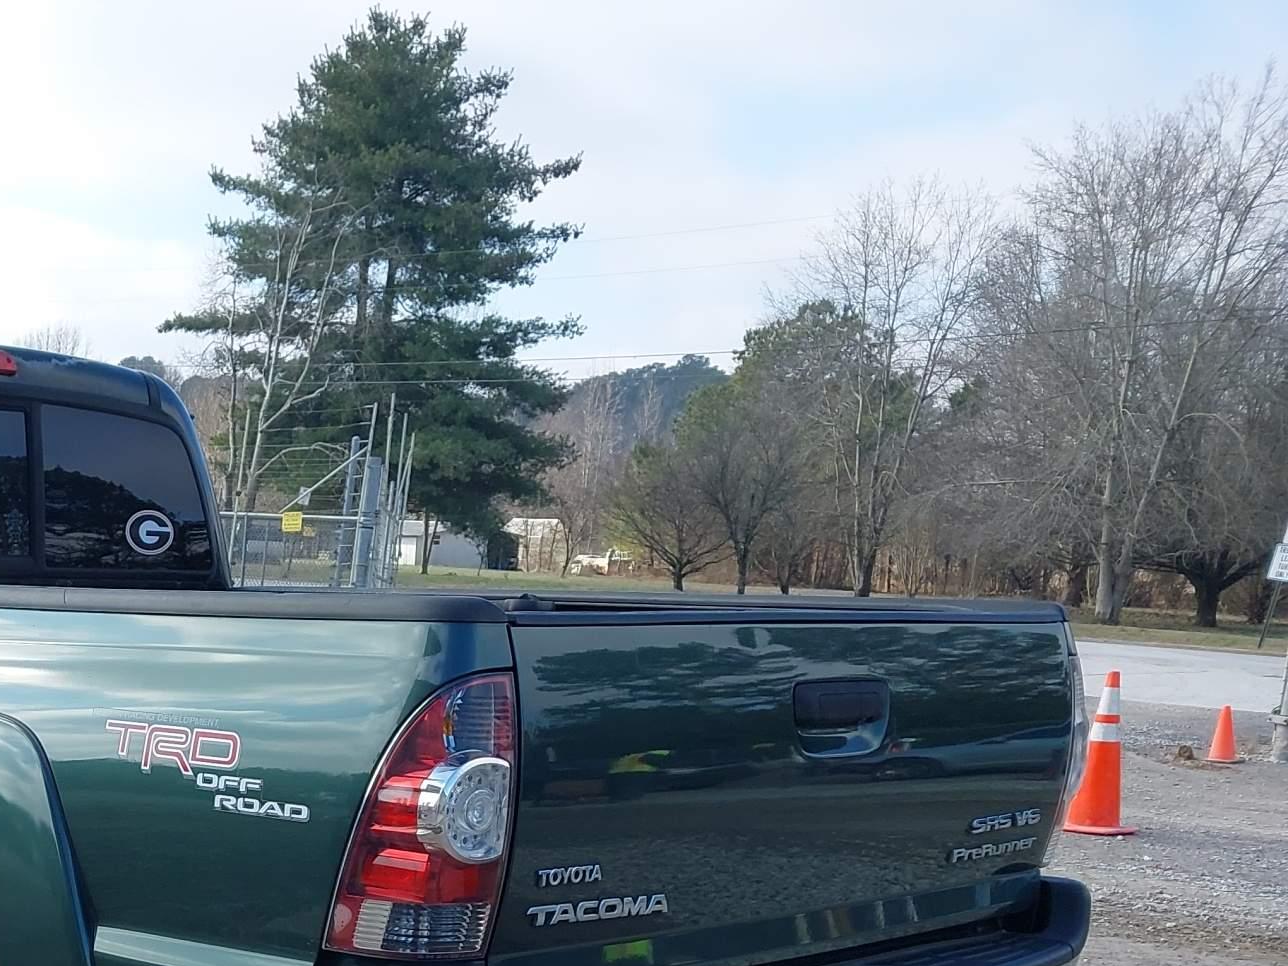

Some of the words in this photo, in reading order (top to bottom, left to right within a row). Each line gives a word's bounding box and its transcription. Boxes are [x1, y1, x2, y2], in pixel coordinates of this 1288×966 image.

[106, 719, 241, 778] TRD
[196, 772, 262, 793] OFF
[214, 794, 311, 822] ROAD
[1015, 808, 1041, 826] V6
[951, 837, 1038, 863] PreRunner
[538, 864, 602, 888] TOYOTA
[526, 894, 668, 927] TACOMA
